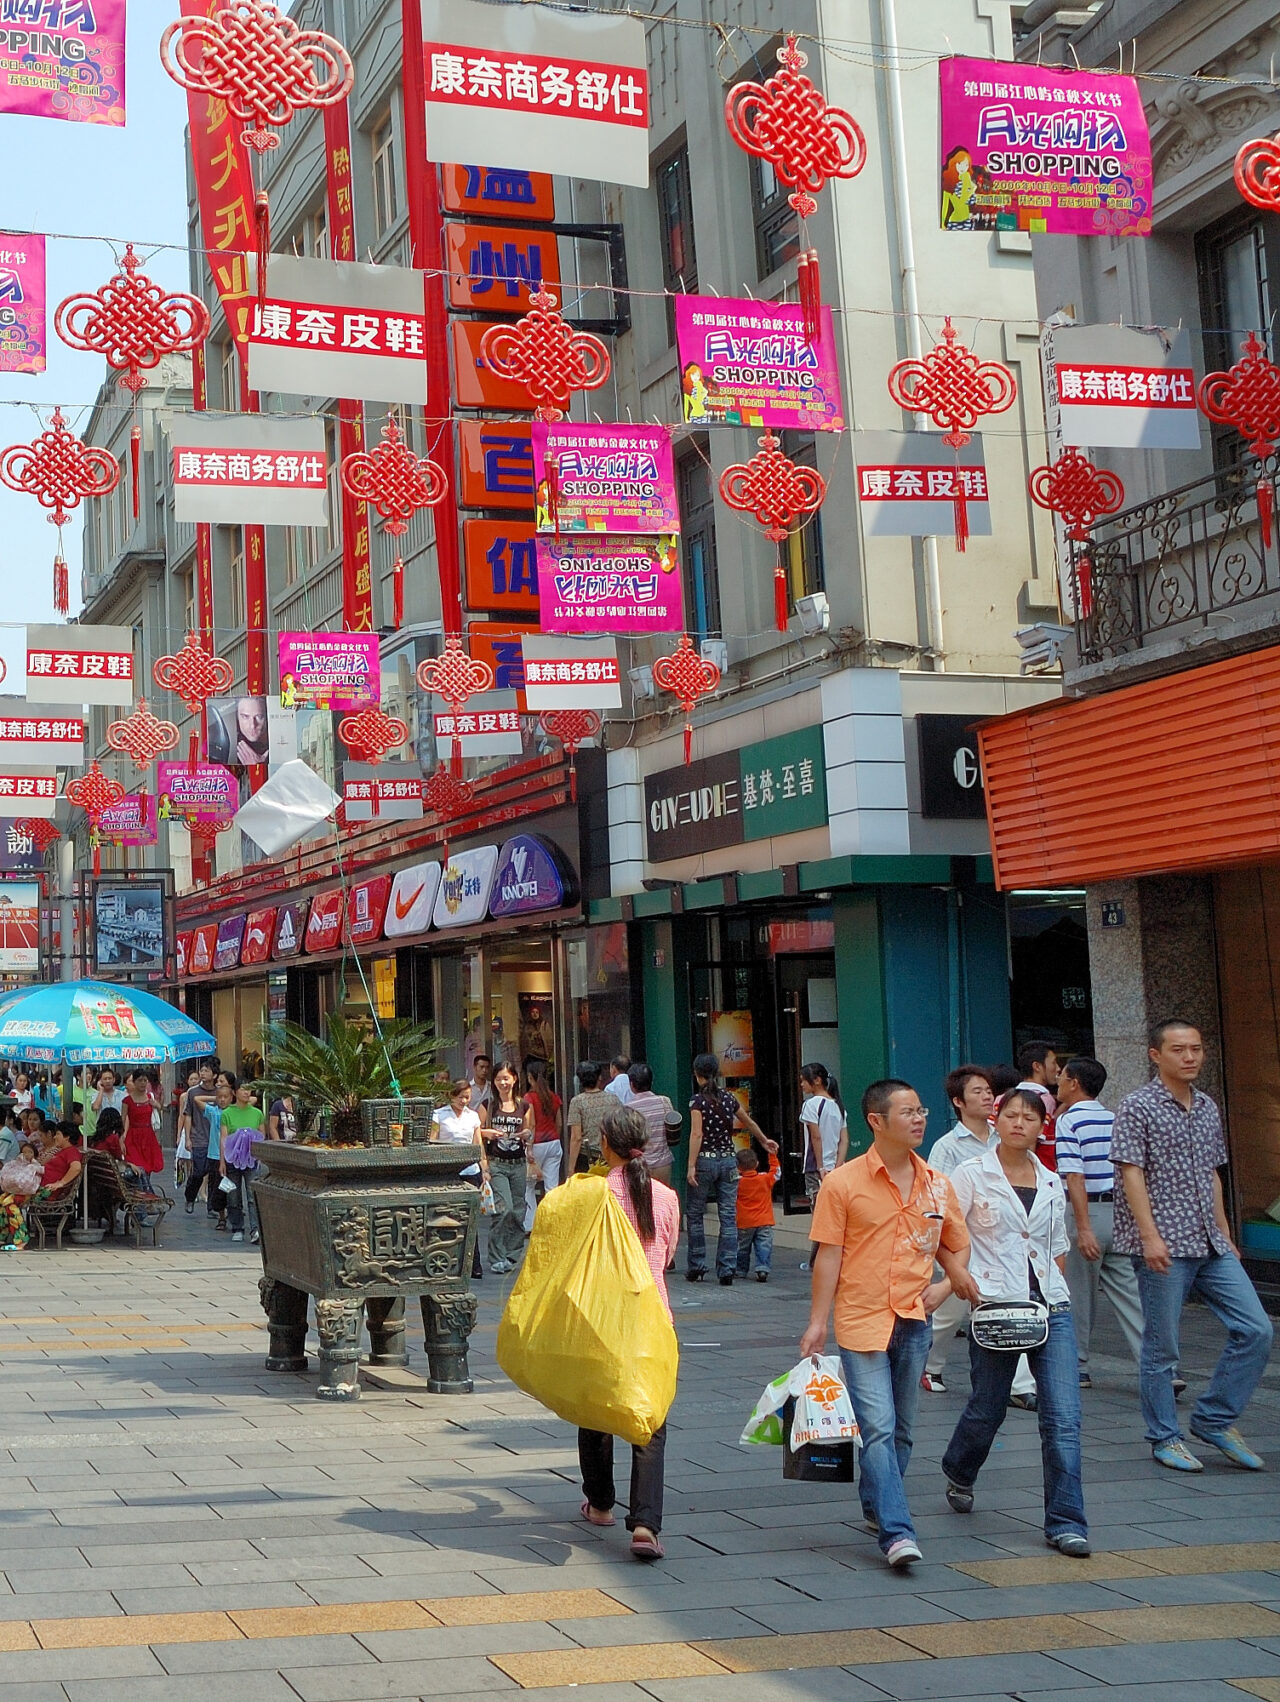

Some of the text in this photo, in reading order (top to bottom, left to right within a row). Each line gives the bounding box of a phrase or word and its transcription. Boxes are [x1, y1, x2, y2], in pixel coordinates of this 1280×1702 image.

[430, 52, 644, 117] 康奈商务舒仕
[964, 81, 1122, 107] 第四届江心屿金秋文化节
[977, 103, 1127, 152] 月光购物
[987, 152, 1120, 177] SHOPPING
[252, 304, 424, 355] 康奈皮鞋
[692, 312, 814, 332] 第四届江心屿金秋文化
[705, 330, 818, 368] 月光购物
[713, 366, 815, 388] SHOPPING
[1061, 369, 1193, 402] 康奈商务舒仕
[178, 452, 324, 483] 康奈商务舒仕
[558, 450, 659, 480] 月光购物
[564, 482, 654, 496] SHOPPING
[861, 466, 987, 498] 康奈皮鞋
[560, 558, 651, 572] SHOPPING
[28, 652, 131, 677] 康奈皮鞋
[296, 652, 369, 673] 月光购物
[526, 660, 620, 684] 康奈商务舒仕
[300, 674, 366, 685] SHOPPING
[436, 712, 520, 732] 康奈皮鞋
[175, 794, 226, 802] SHOPPING
